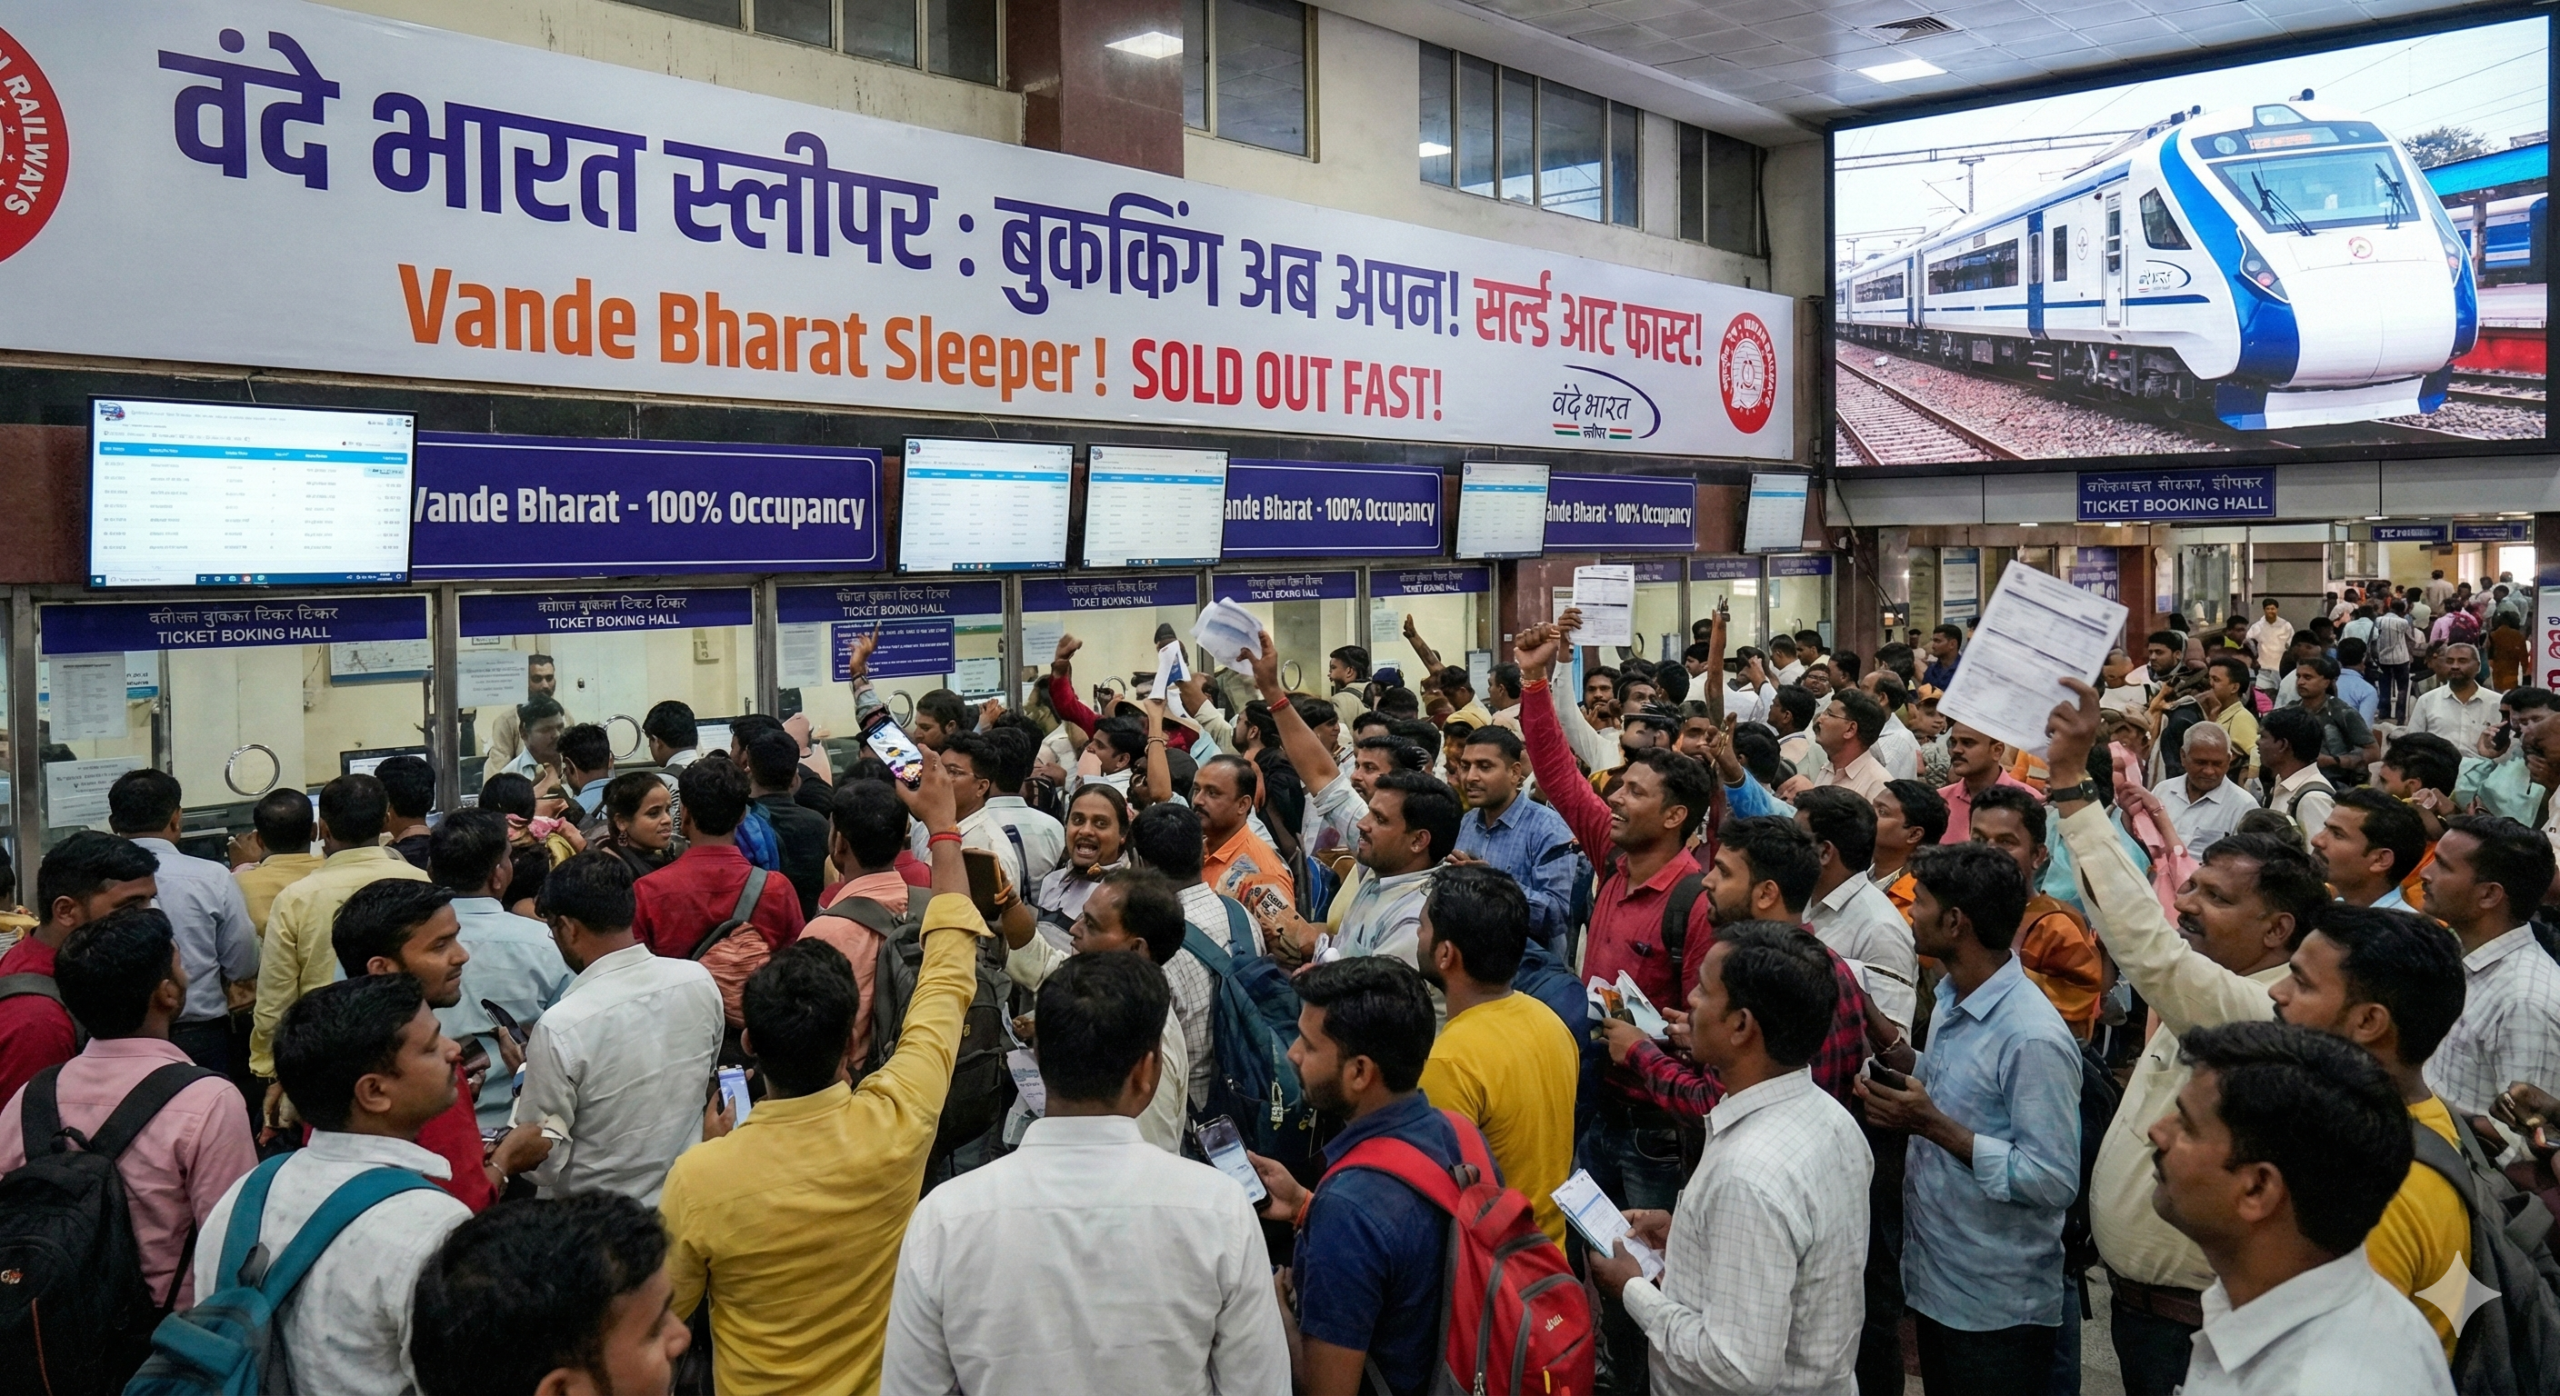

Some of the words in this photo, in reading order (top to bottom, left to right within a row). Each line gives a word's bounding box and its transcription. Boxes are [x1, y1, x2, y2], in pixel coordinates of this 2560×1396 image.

[4, 74, 49, 216] RAILWAYS
[158, 28, 341, 191] वंदे
[372, 91, 647, 233] भारत
[663, 131, 939, 271] स्लीपर
[994, 191, 1224, 316] बुककिंग
[1240, 238, 1322, 319] अब
[1335, 253, 1460, 337] अपन!
[1560, 292, 1618, 356] आट
[1622, 302, 1703, 367] फास्ट!
[398, 264, 636, 364] Vande
[659, 292, 870, 379] Bharat
[884, 315, 1081, 403] Sleeper
[1132, 338, 1244, 407] SOLD
[1256, 351, 1333, 412] OUT
[1343, 360, 1442, 420] FAST!
[1552, 383, 1582, 421] वंदे
[1584, 393, 1632, 421] भारत
[517, 486, 620, 524] Bharat
[646, 490, 723, 524] 100%
[729, 491, 866, 531] Occupancy
[1225, 493, 1261, 521] ande
[1263, 494, 1313, 521] Bharat
[1325, 497, 1363, 522] 100%
[1365, 497, 1436, 527] Occupancy
[1573, 500, 1607, 523] Bharat
[1614, 502, 1641, 524] 100%
[2083, 499, 2139, 513] TICKET
[2143, 497, 2219, 512] BOOKING
[2224, 496, 2268, 510] HALL
[548, 616, 593, 629] TICKET
[596, 615, 645, 628] BOKING
[648, 613, 681, 626] HALL
[843, 605, 878, 617] TICKET
[920, 603, 946, 615] HALL
[157, 630, 217, 644] TICKET
[221, 627, 286, 642] BOKING
[290, 626, 332, 640] HALL
